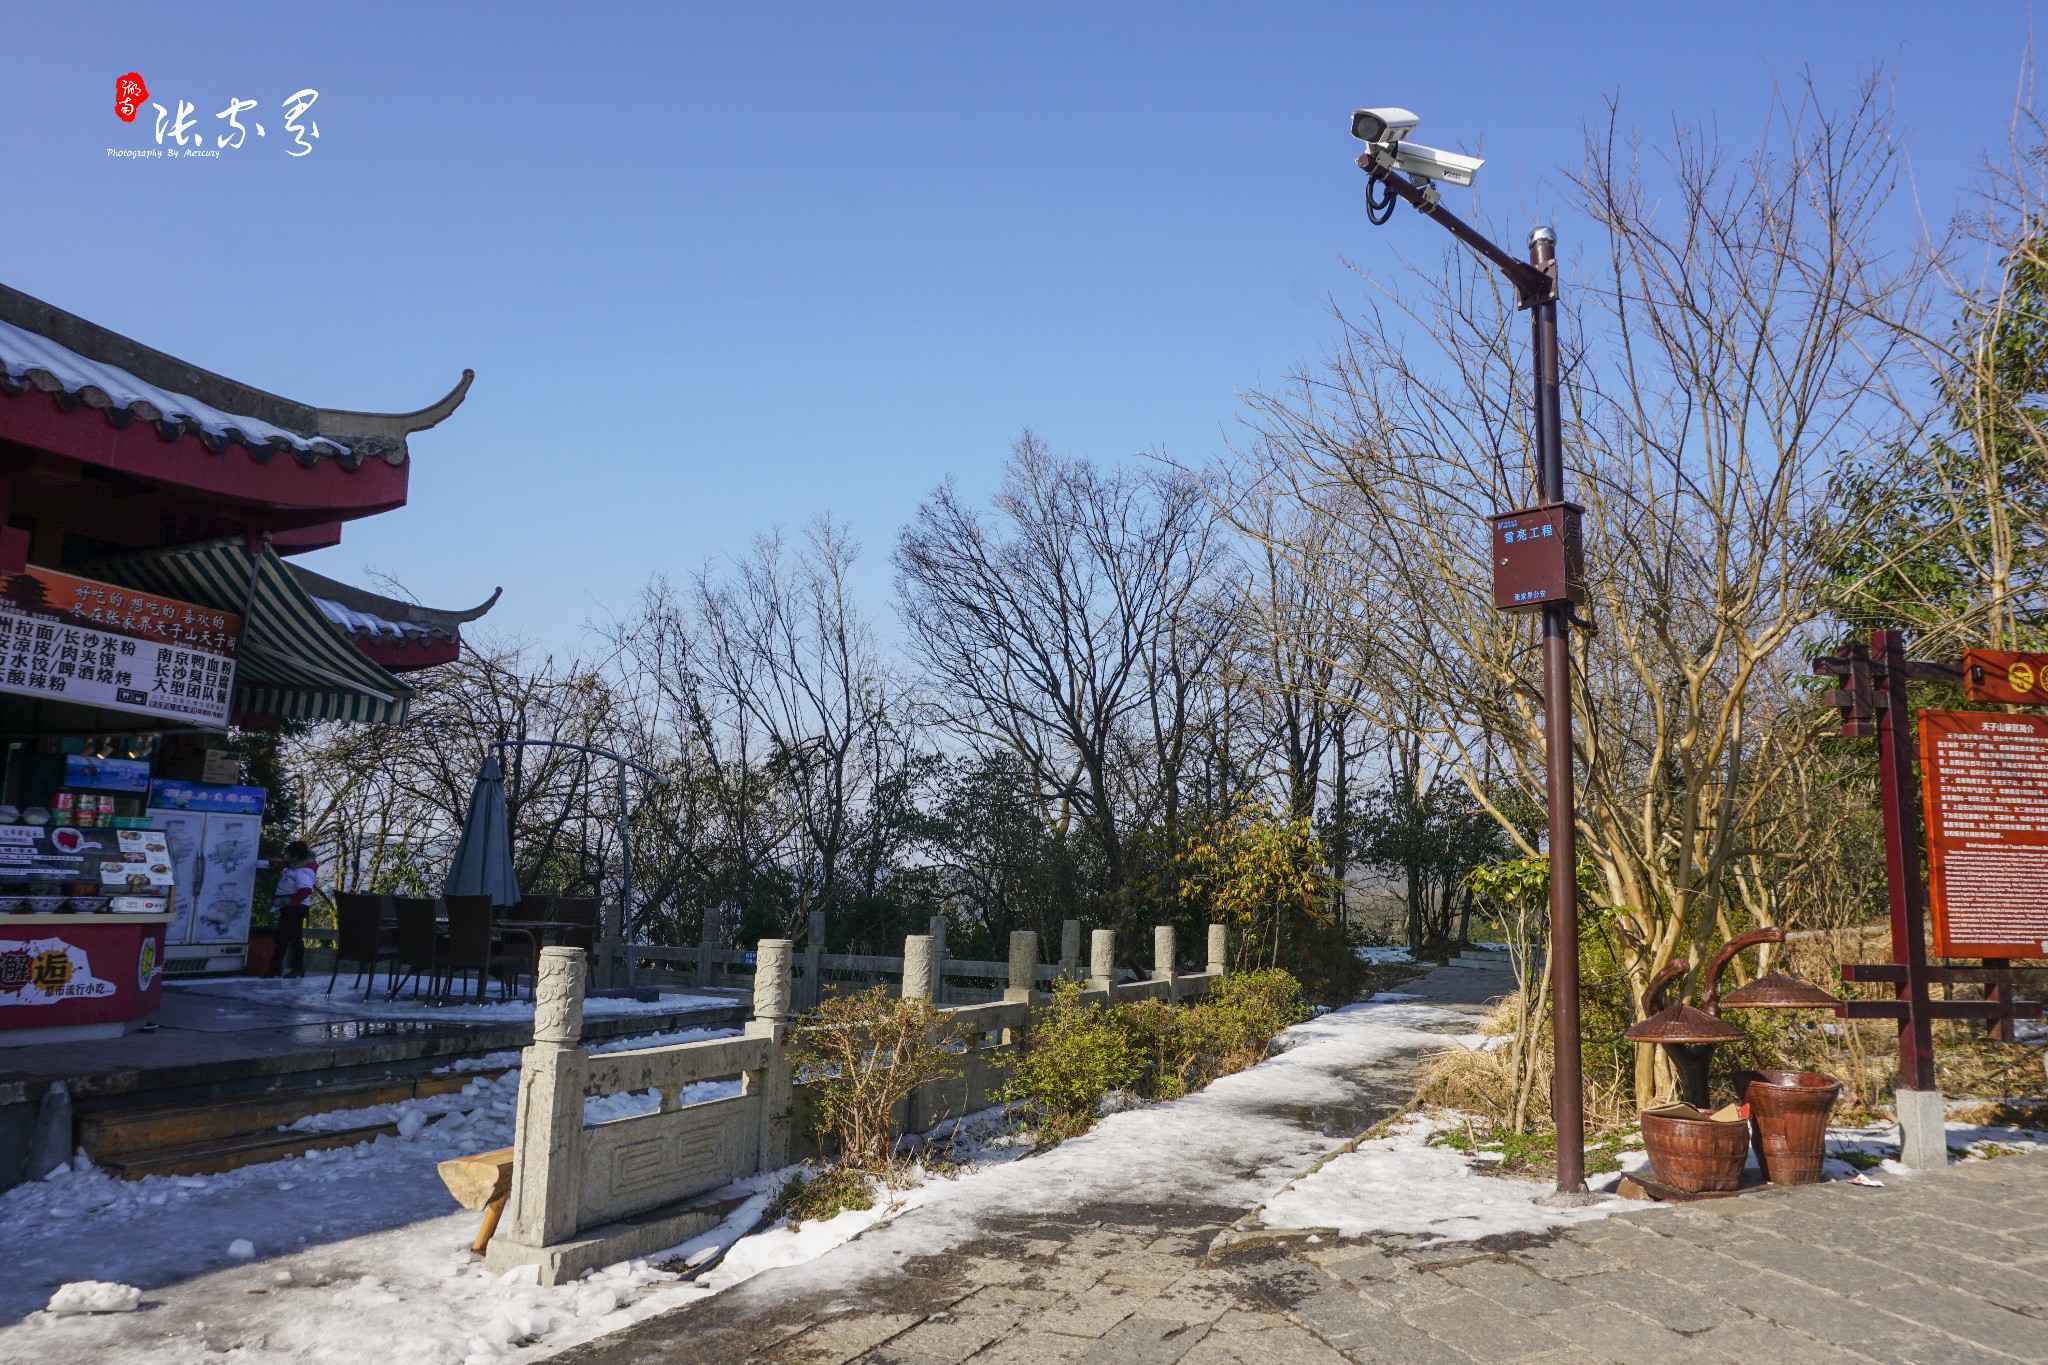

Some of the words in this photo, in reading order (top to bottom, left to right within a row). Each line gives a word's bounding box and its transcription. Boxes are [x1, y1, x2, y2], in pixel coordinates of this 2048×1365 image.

[1504, 524, 1553, 544] 雪亮工程
[74, 584, 225, 630] 好吃的/想吃的/喜欢的
[157, 648, 232, 676] 南京鸭血粉
[0, 669, 66, 692] 酸辣粉
[155, 663, 230, 690] 长沙臭豆腐
[151, 677, 227, 704] 大型团队餐
[1981, 722, 2035, 734] 天子山景区简介
[0, 953, 67, 987] 邂逅
